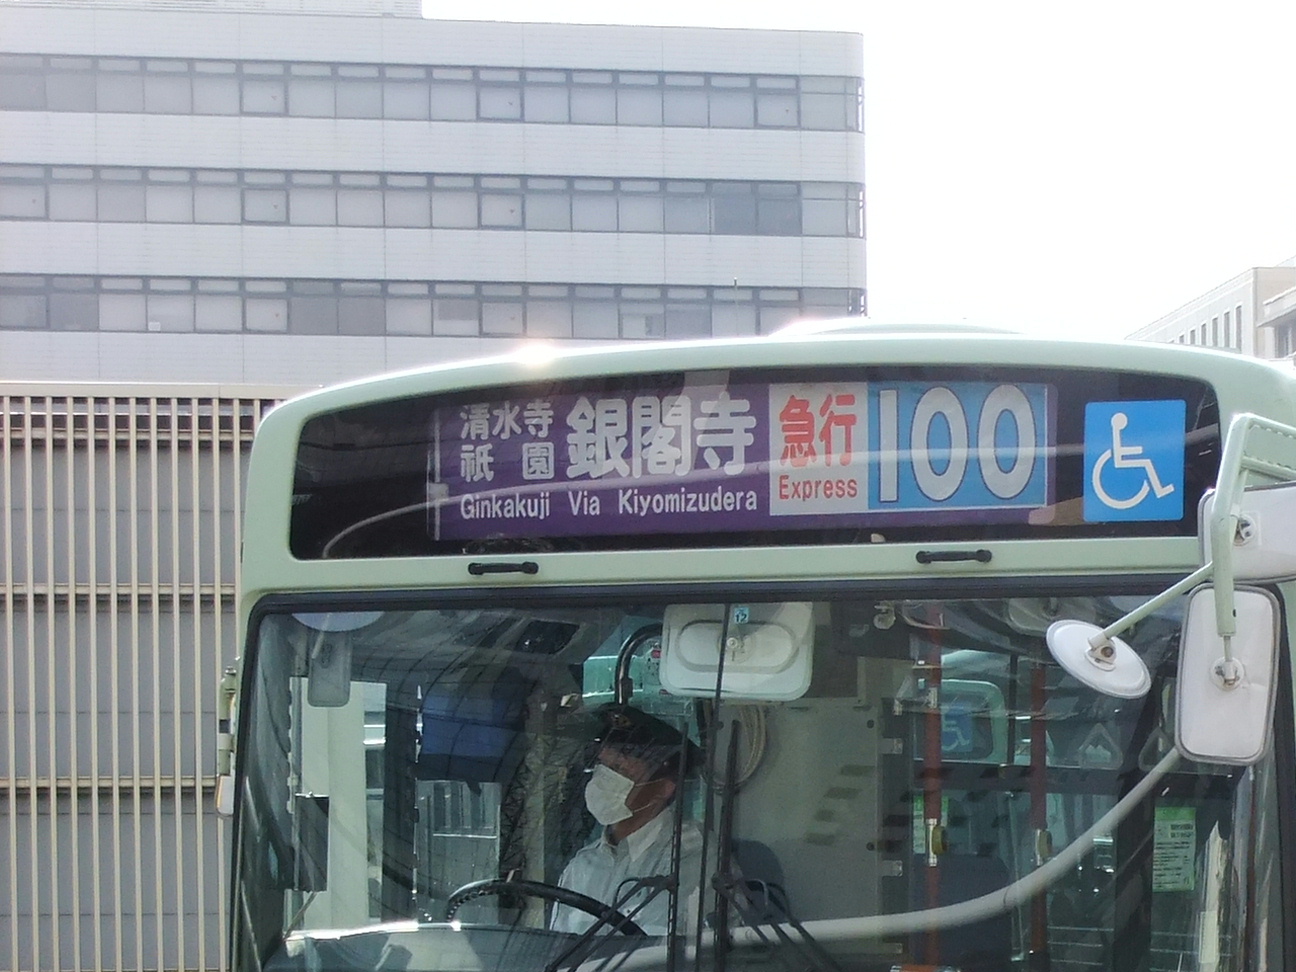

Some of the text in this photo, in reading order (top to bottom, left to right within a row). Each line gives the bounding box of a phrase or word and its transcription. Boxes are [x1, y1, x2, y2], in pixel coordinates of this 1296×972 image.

[460, 401, 554, 441] 清水寺
[566, 391, 757, 479] 銀閣寺
[779, 393, 857, 467] 急行
[879, 384, 1037, 501] 100
[460, 486, 757, 520] Ginkakuji Via Kiyomizudera
[779, 474, 858, 501] Express
